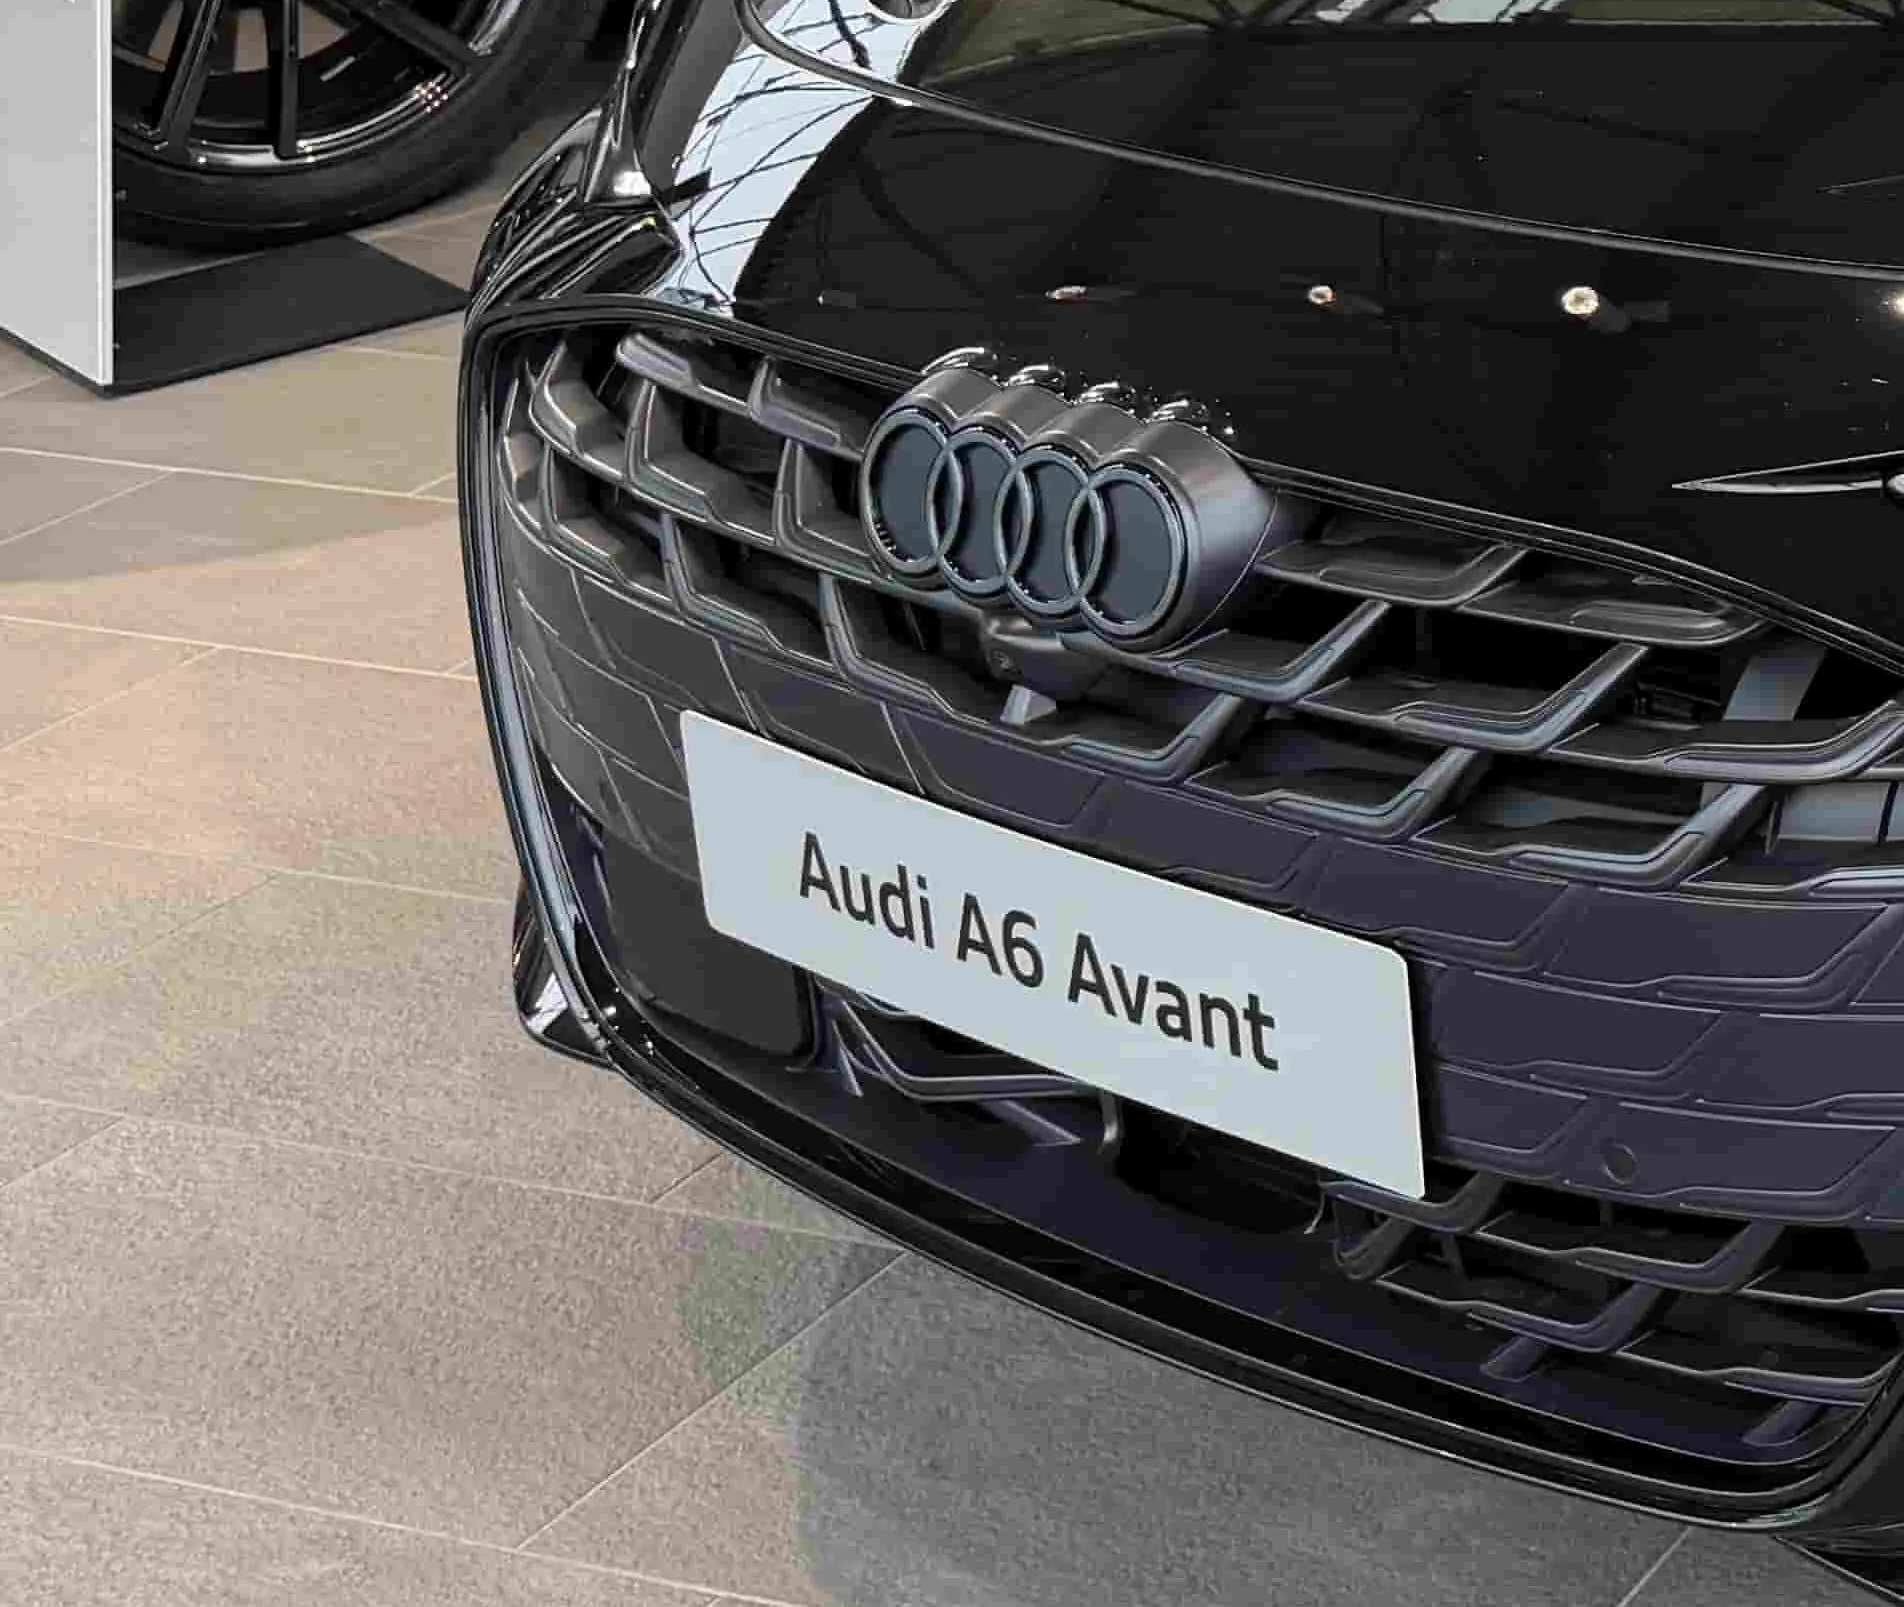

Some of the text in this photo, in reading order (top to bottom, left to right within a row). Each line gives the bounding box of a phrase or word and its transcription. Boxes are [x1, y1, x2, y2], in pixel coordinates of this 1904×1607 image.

[800, 831, 1279, 1072] Audi A6 Avant
